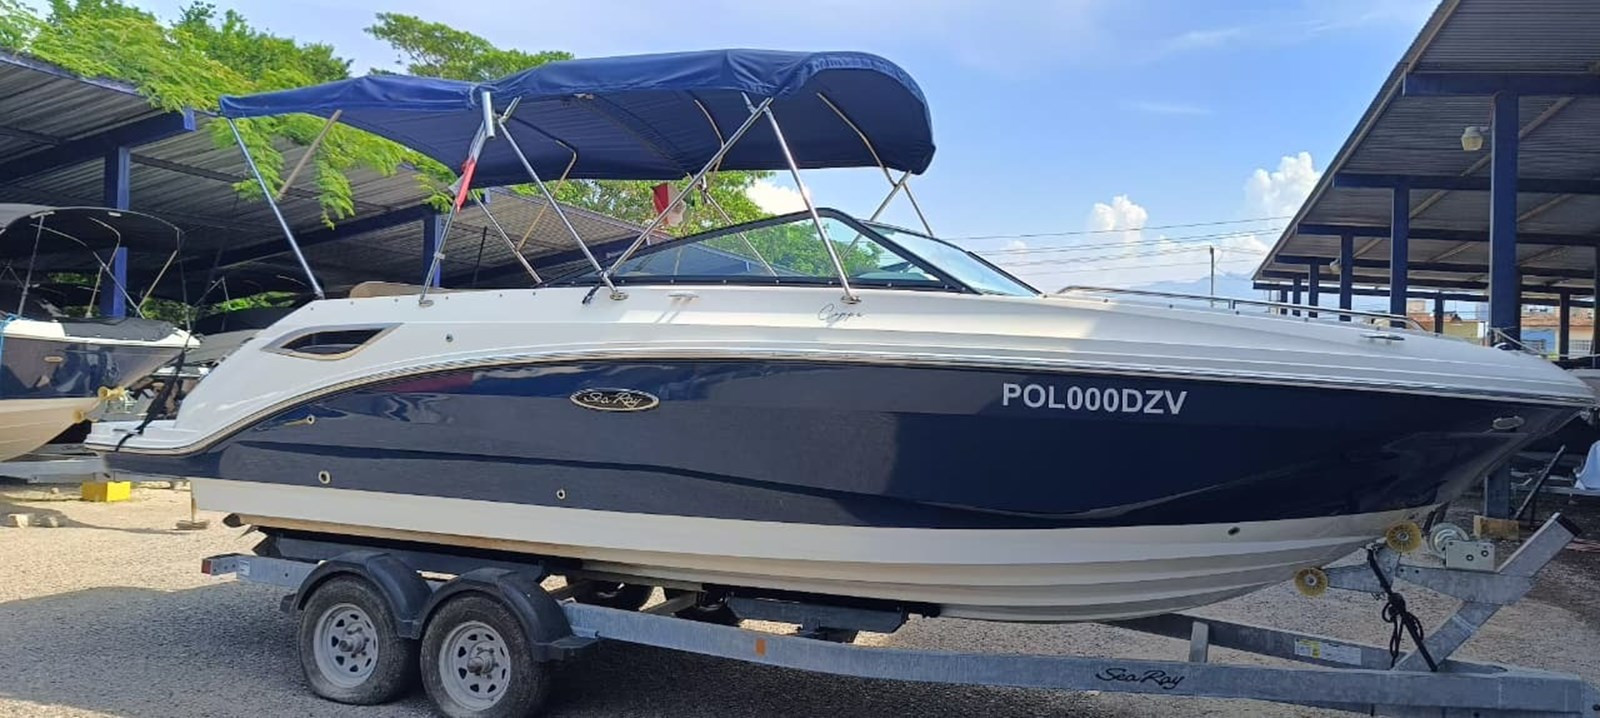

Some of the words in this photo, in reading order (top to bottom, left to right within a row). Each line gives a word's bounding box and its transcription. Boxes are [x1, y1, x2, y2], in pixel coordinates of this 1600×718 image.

[583, 392, 610, 404] Sea
[612, 392, 643, 408] Ray
[1002, 383, 1187, 415] POL000DZV
[1095, 668, 1140, 682] Sea
[1140, 670, 1185, 690] Ray
